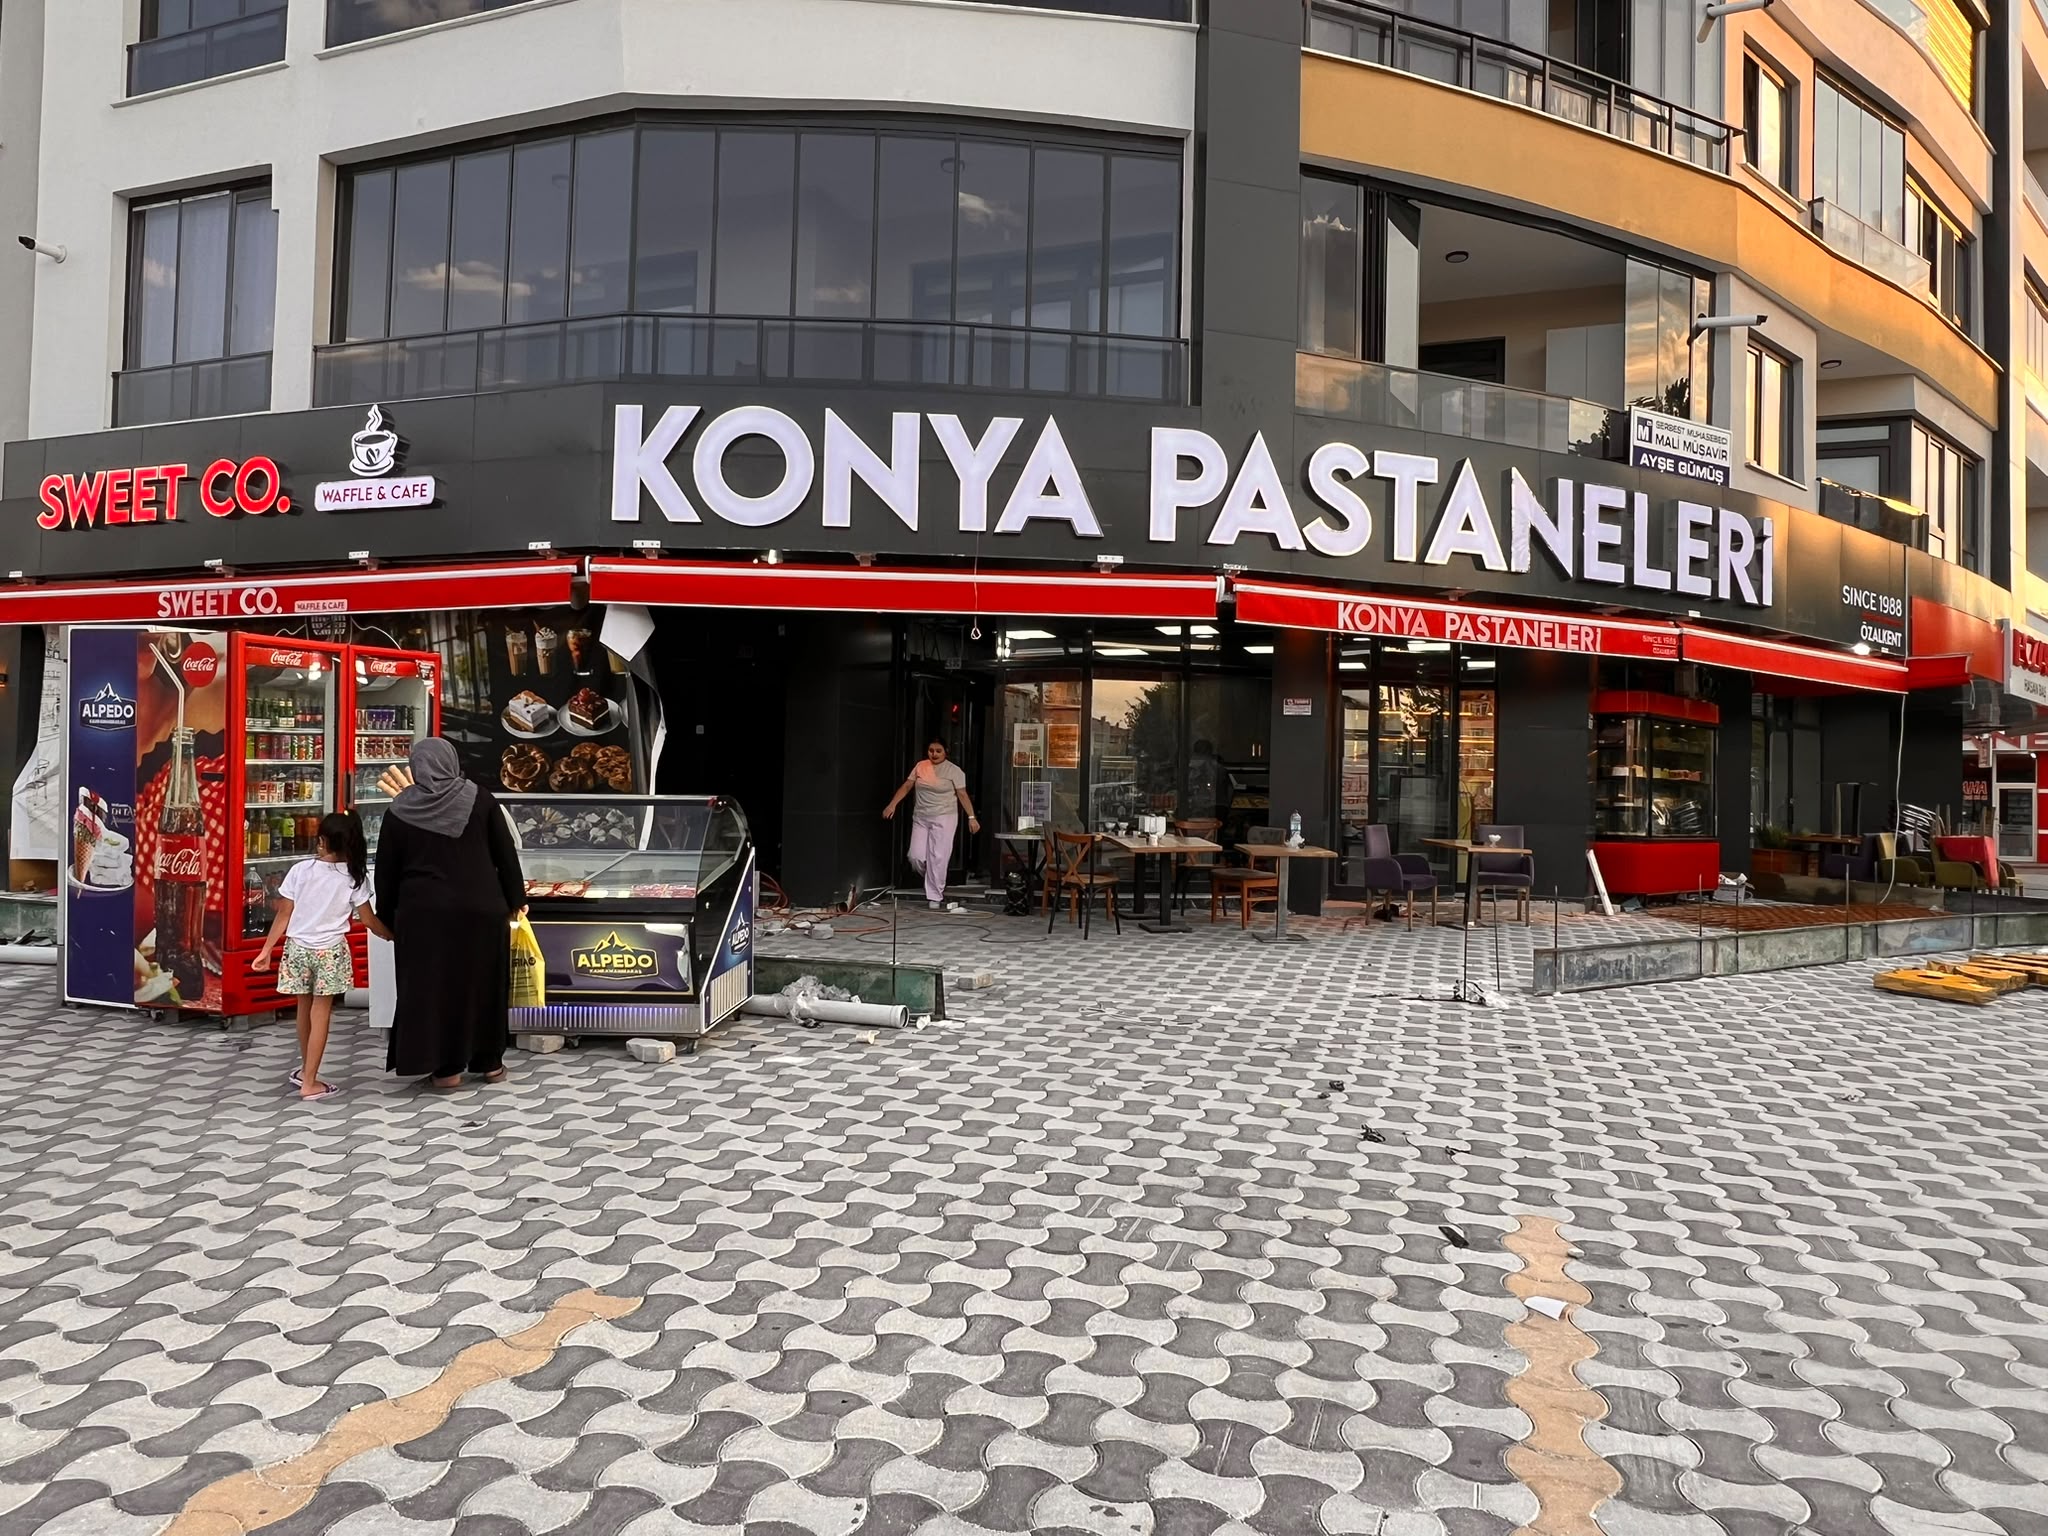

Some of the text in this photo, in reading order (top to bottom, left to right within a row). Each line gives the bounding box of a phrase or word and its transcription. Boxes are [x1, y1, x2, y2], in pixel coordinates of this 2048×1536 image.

[1640, 452, 1724, 486] AYŞE GÜMÜŞ
[36, 455, 291, 531] SWEET CO.
[322, 482, 429, 504] WAFFLE & CAFE
[611, 404, 1774, 607] KONYA PASTANELERİ
[157, 587, 283, 618] SWEET CO.
[297, 602, 321, 611] WAFFLE
[328, 601, 345, 610] CAFE
[1842, 585, 1903, 617] SINCE 1988
[1337, 602, 1602, 653] KONYA PASTANELERİ
[1860, 621, 1902, 648] ÖZALKENT
[82, 703, 134, 719] ALPEDO
[577, 953, 653, 969] ALPEDO
